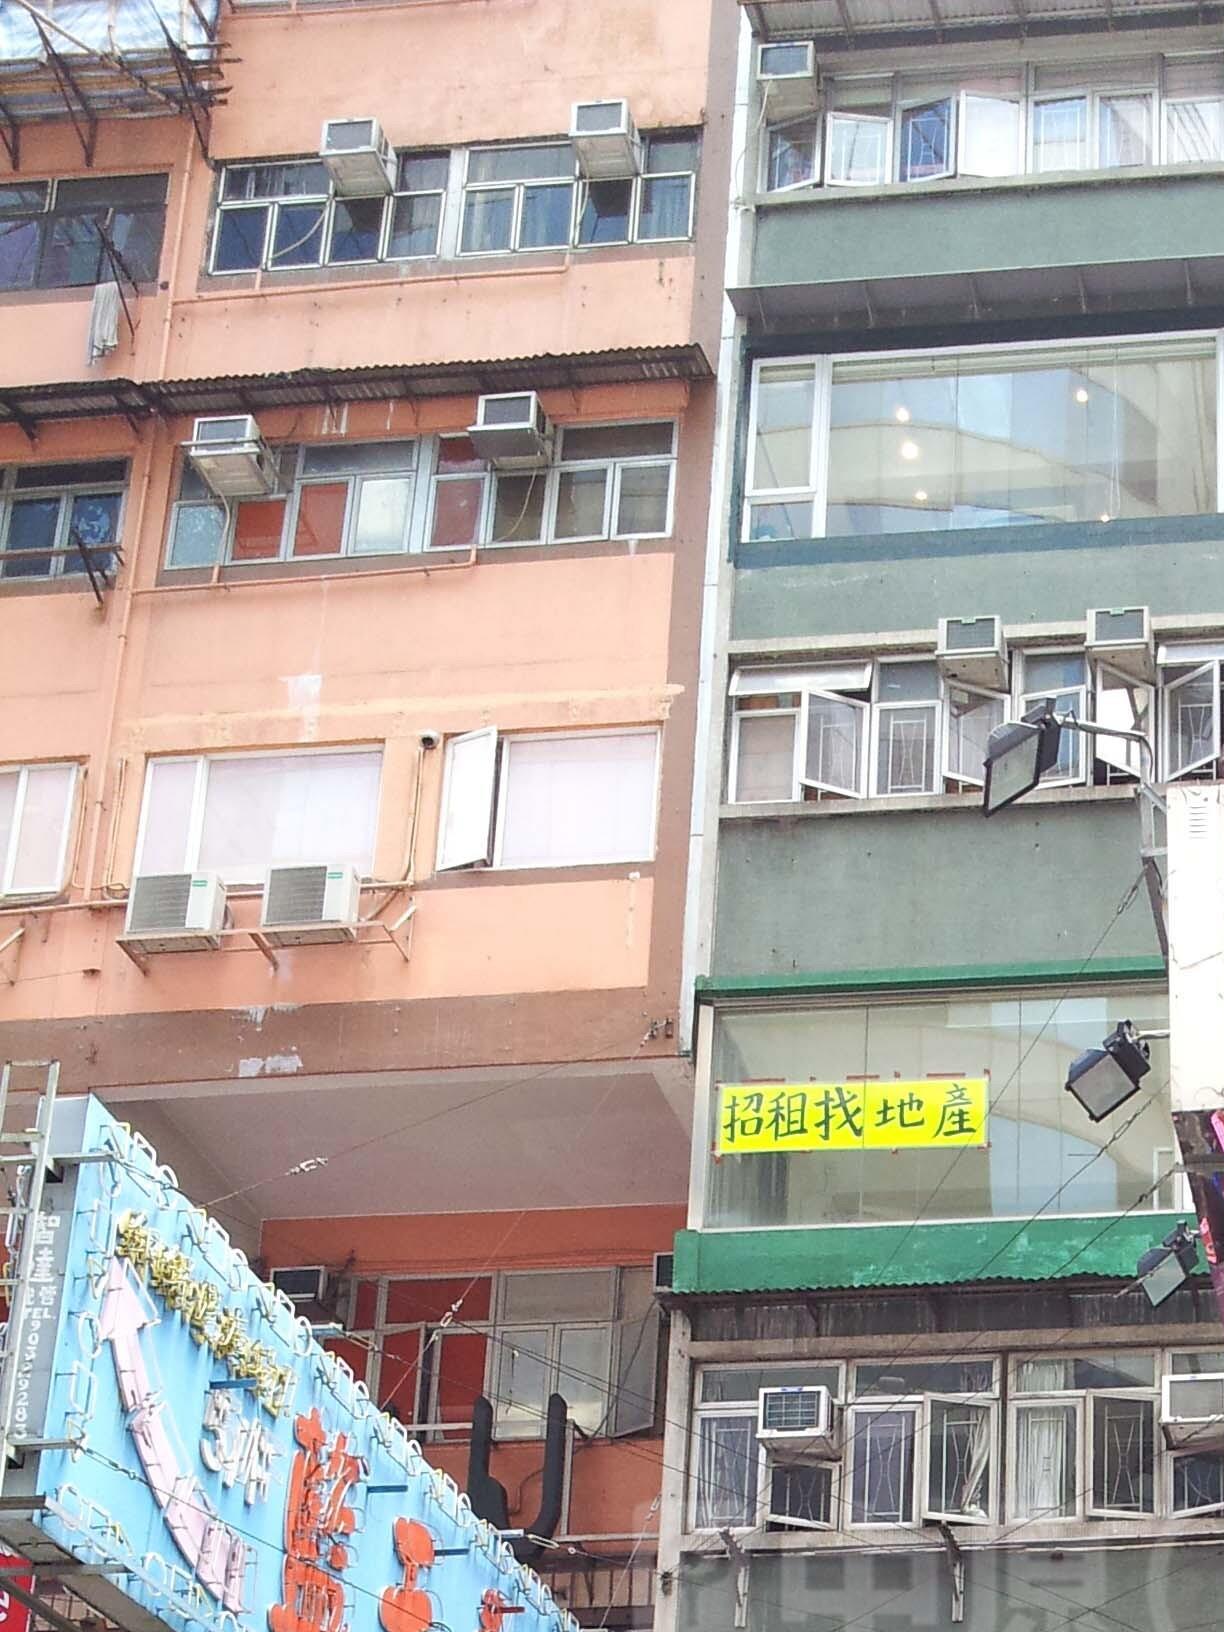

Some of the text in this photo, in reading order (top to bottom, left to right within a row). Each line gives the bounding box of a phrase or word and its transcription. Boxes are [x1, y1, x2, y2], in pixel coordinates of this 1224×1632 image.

[723, 1082, 977, 1143] 招租找地產
